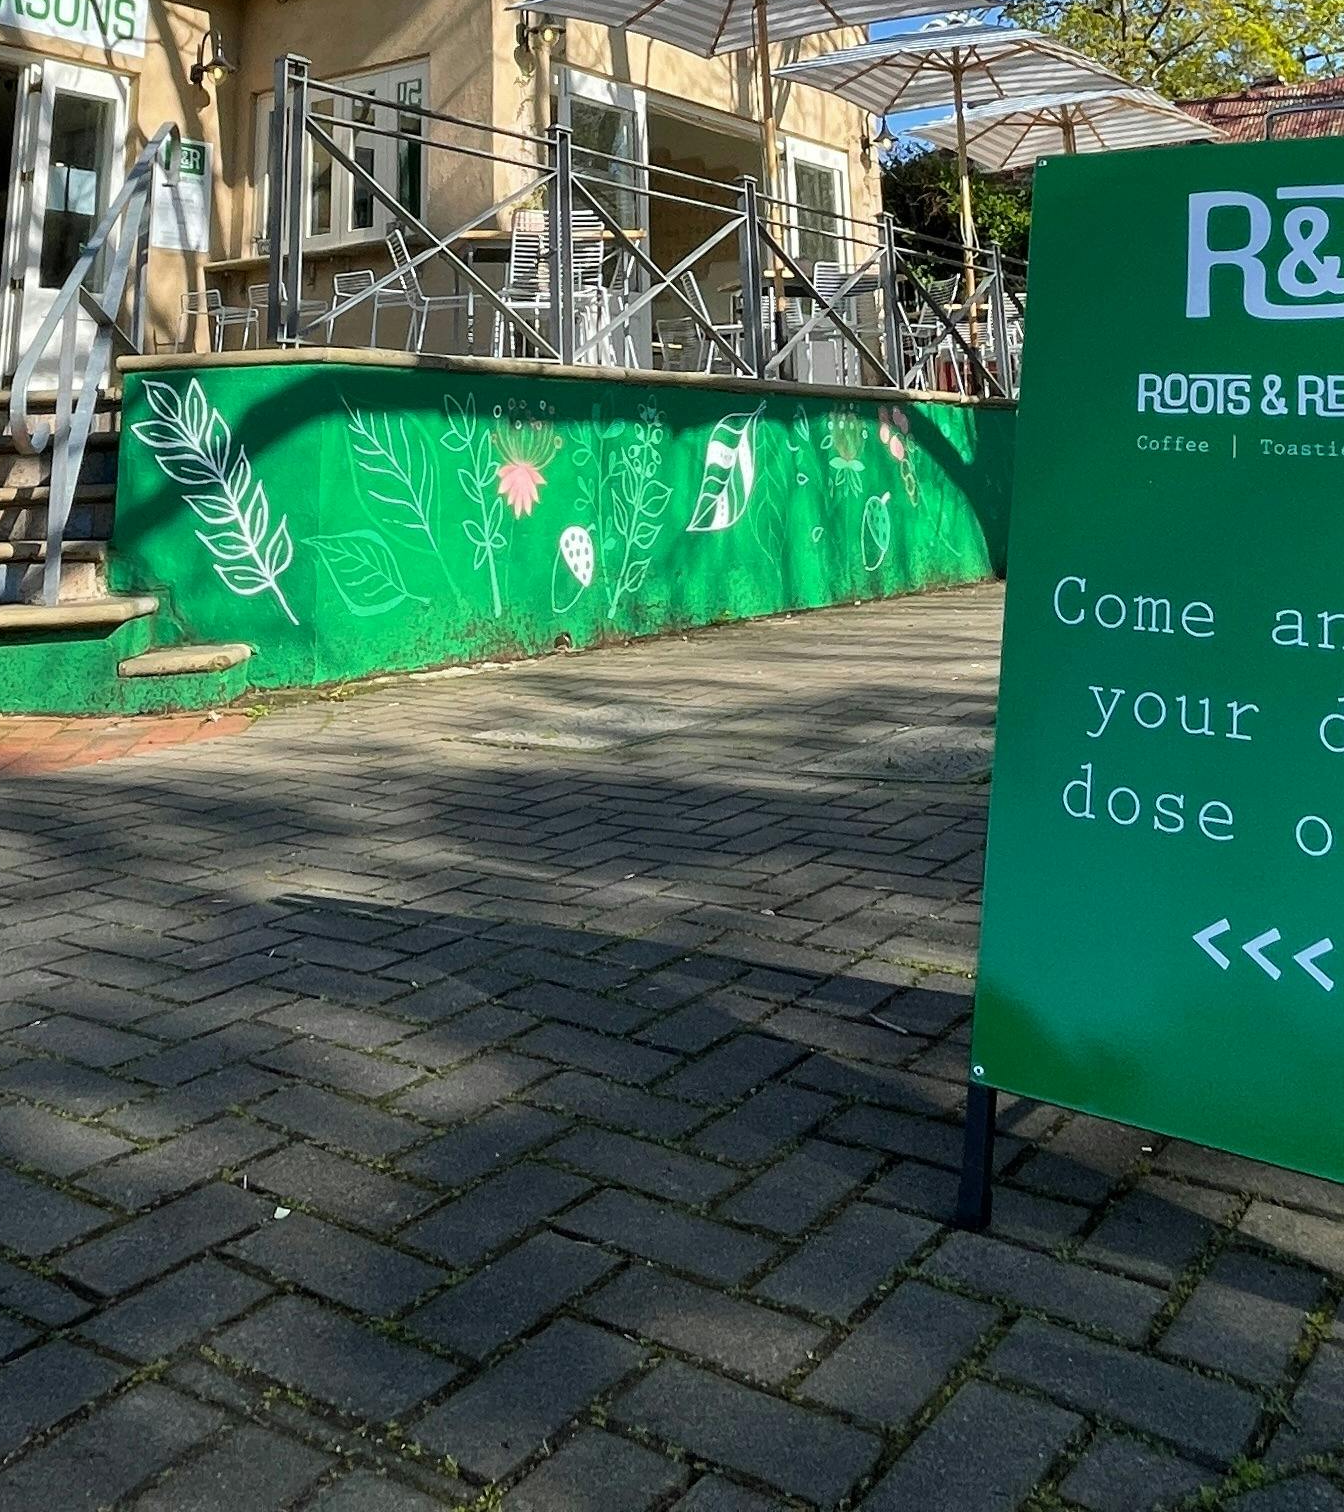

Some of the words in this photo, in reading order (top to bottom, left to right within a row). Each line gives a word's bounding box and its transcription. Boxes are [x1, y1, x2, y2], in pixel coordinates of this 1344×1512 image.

[1137, 372, 1253, 415] ROOTS
[1260, 374, 1289, 416] &
[1136, 435, 1210, 454] Coffee
[1053, 575, 1216, 639] Come
[1085, 684, 1260, 742] your
[1062, 762, 1234, 842] dose
